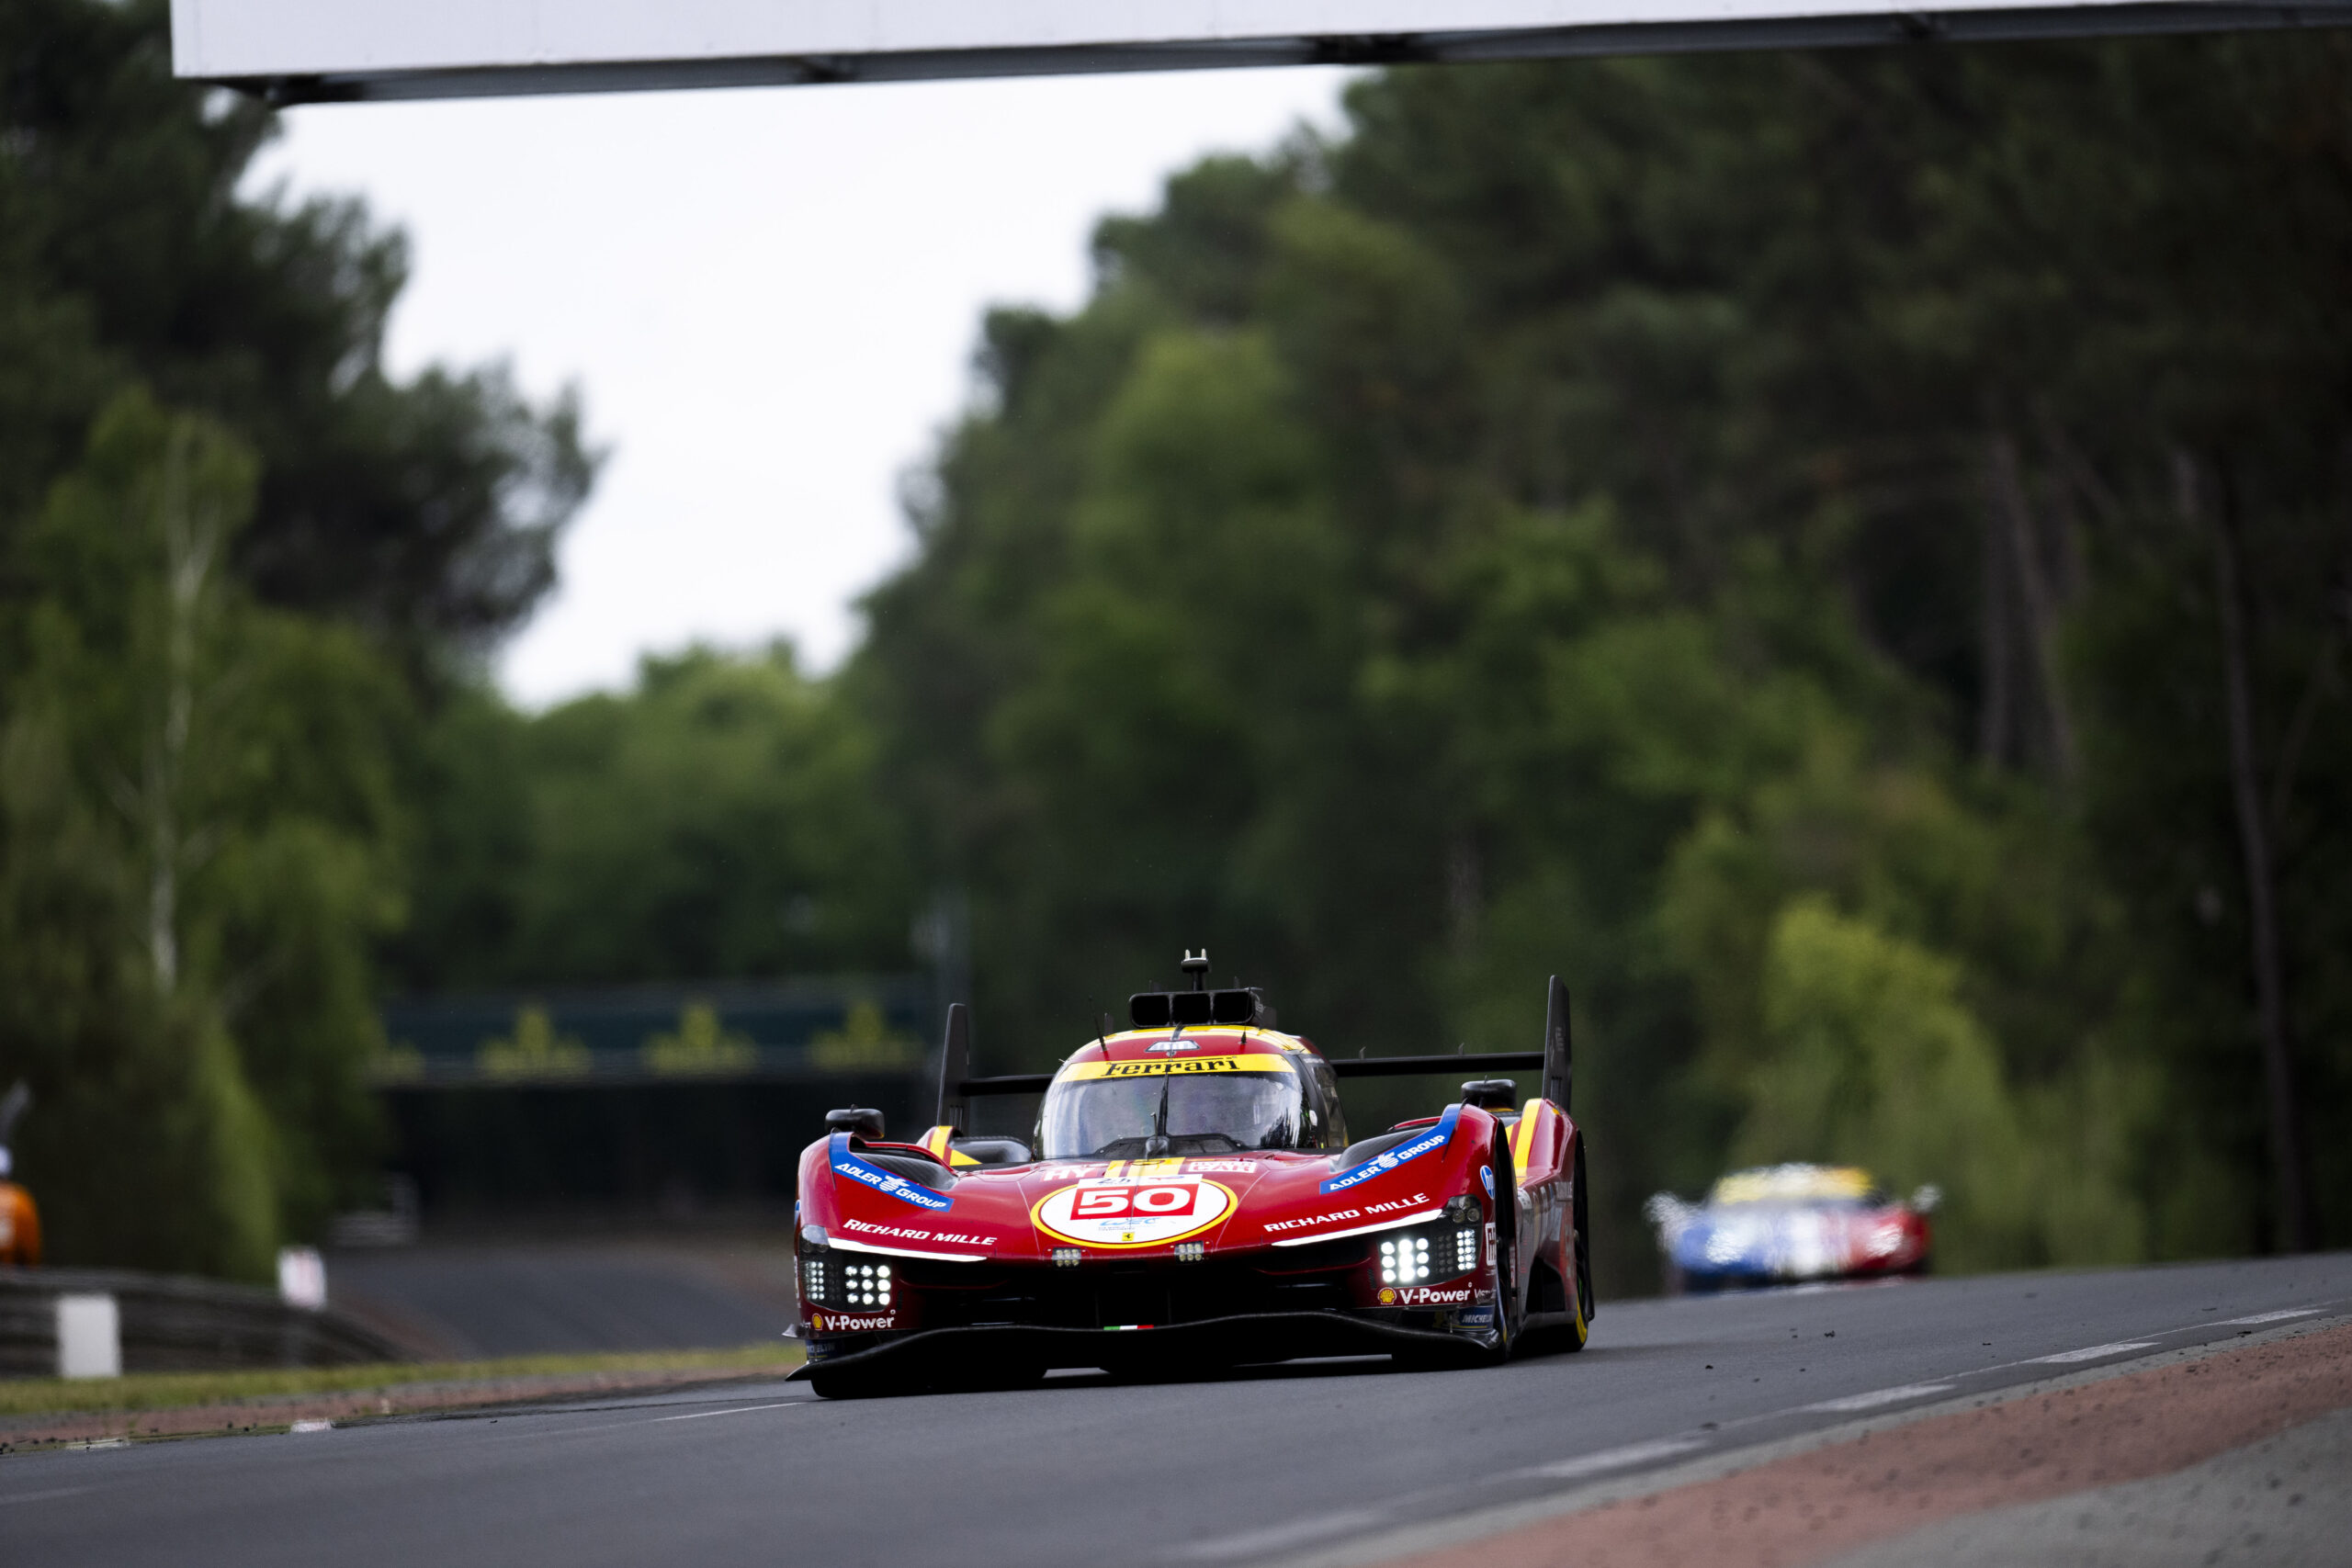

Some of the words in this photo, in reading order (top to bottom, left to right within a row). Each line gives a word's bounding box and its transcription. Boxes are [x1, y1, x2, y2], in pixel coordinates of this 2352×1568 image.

[1102, 1057, 1240, 1077] Ferrari
[1329, 1166, 1382, 1190] ADLER
[1396, 1134, 1446, 1160] GROUP
[834, 1163, 882, 1186] ADLER
[895, 1188, 946, 1209] GROUP
[1078, 1188, 1191, 1215] 50
[1263, 1209, 1361, 1233] RICHARD
[1365, 1192, 1430, 1214] MILLE
[842, 1219, 931, 1240] RICHARD
[933, 1233, 998, 1246] MILLE
[1399, 1288, 1471, 1304] V-Power
[824, 1315, 895, 1331] V-Power
